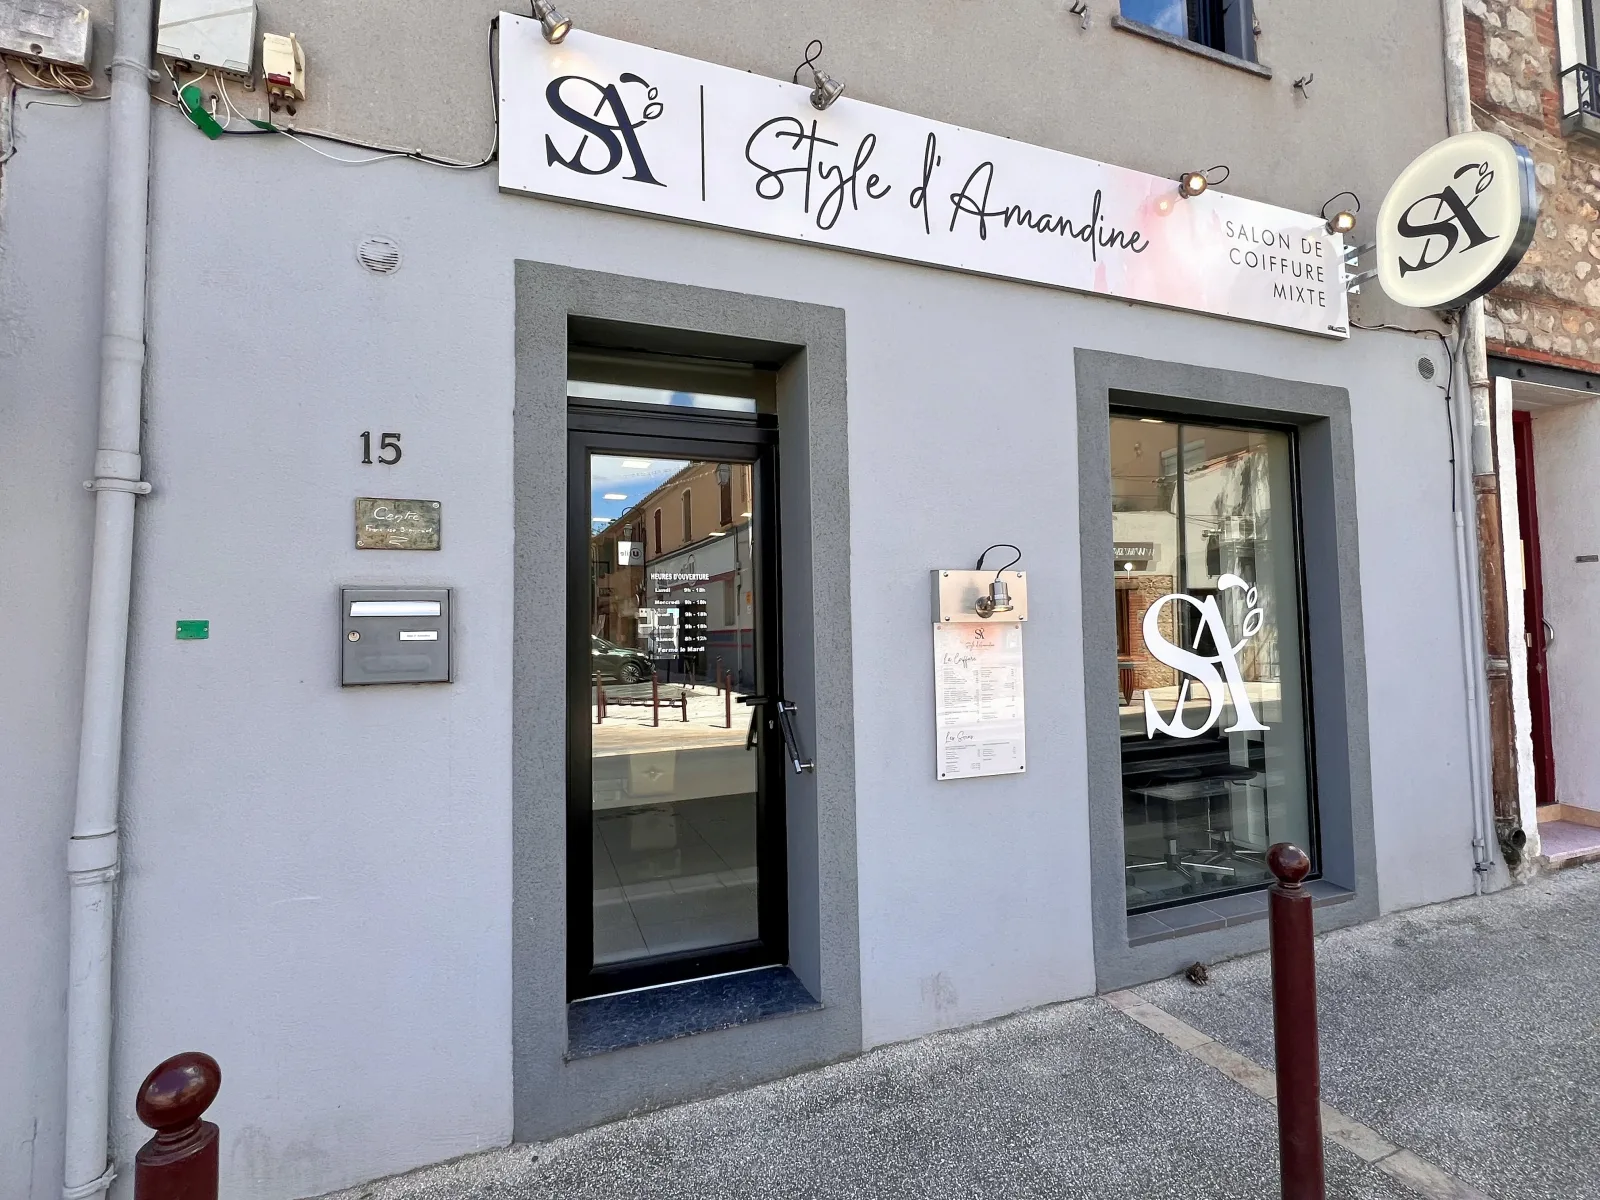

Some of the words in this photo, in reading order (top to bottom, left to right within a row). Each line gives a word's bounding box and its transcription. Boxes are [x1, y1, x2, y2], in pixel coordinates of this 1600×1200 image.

[744, 115, 892, 230] Style
[1226, 220, 1290, 250] SALON
[1301, 238, 1323, 258] DE
[1229, 247, 1324, 283] COIFFURE
[1273, 282, 1326, 308] MIXTE
[360, 431, 402, 465] 15
